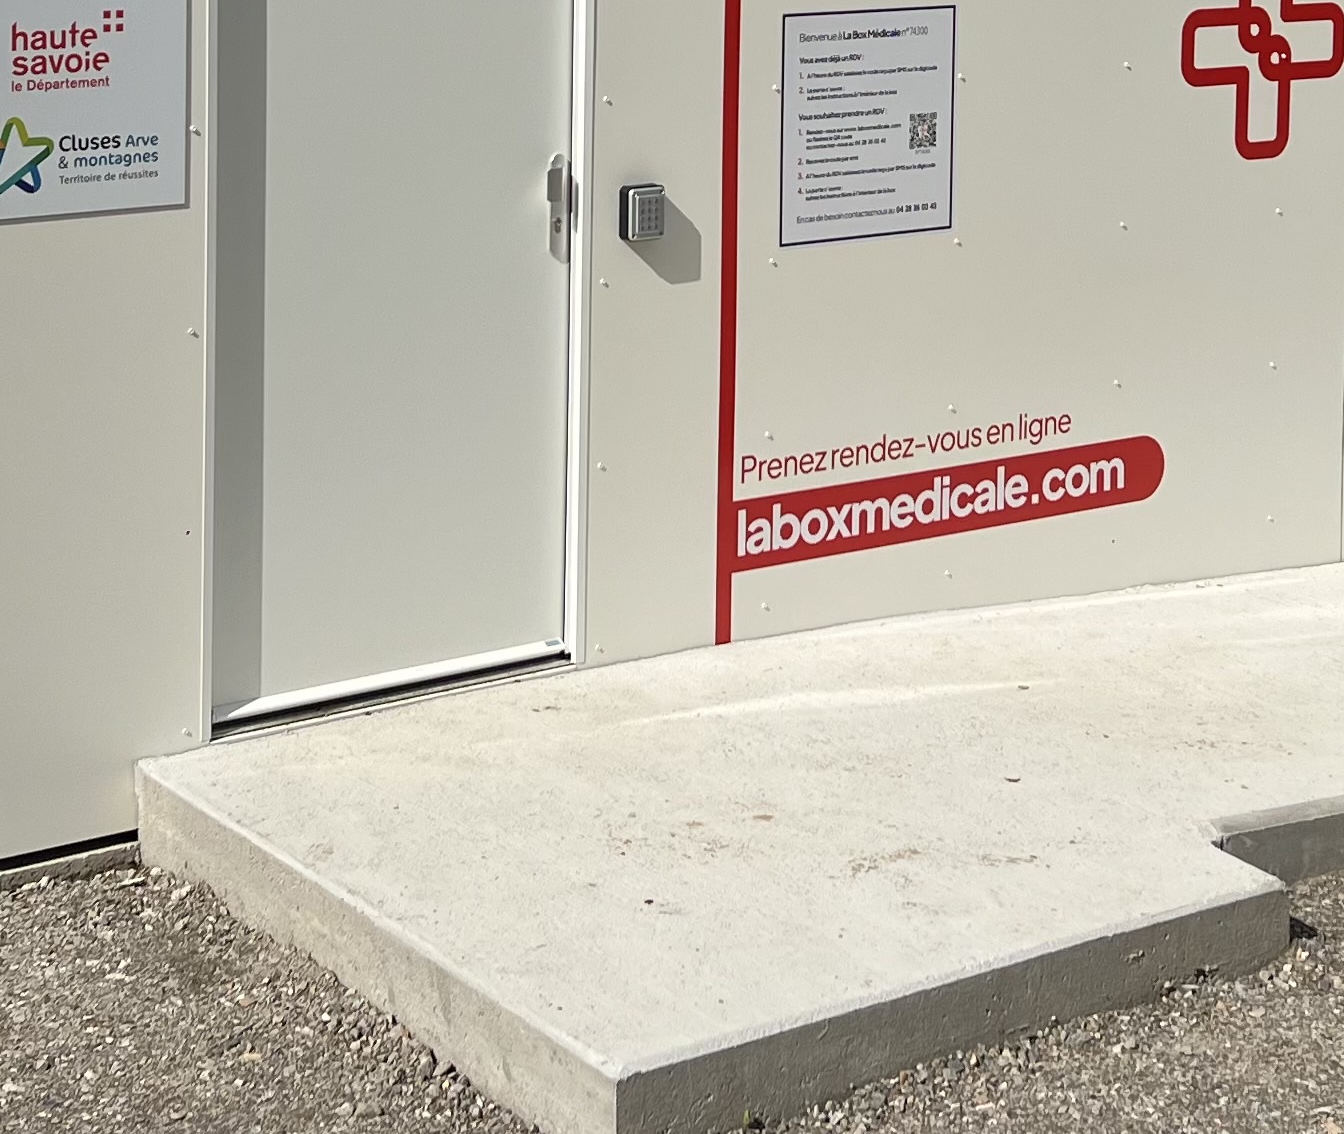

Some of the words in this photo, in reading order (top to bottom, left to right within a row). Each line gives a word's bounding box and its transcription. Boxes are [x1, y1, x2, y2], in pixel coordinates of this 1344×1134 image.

[11, 20, 98, 52] haute
[799, 32, 837, 43] Bienvenue
[843, 30, 852, 41] La
[852, 29, 867, 40] Box
[867, 27, 901, 39] Médicale
[11, 50, 110, 76] savoie
[11, 80, 23, 92] le
[26, 75, 110, 93] Département
[58, 134, 121, 152] Cluses
[125, 134, 159, 148] Arve
[58, 155, 69, 170] &
[73, 151, 159, 168] montagnes
[58, 173, 102, 185] Territoire
[103, 172, 117, 181] de
[118, 169, 159, 180] réussites
[740, 449, 827, 484] Prenez
[830, 427, 983, 470] rendez-vous
[986, 422, 1015, 445] en
[1018, 412, 1072, 446] ligne
[735, 455, 1126, 558] laboxmedicale.com
